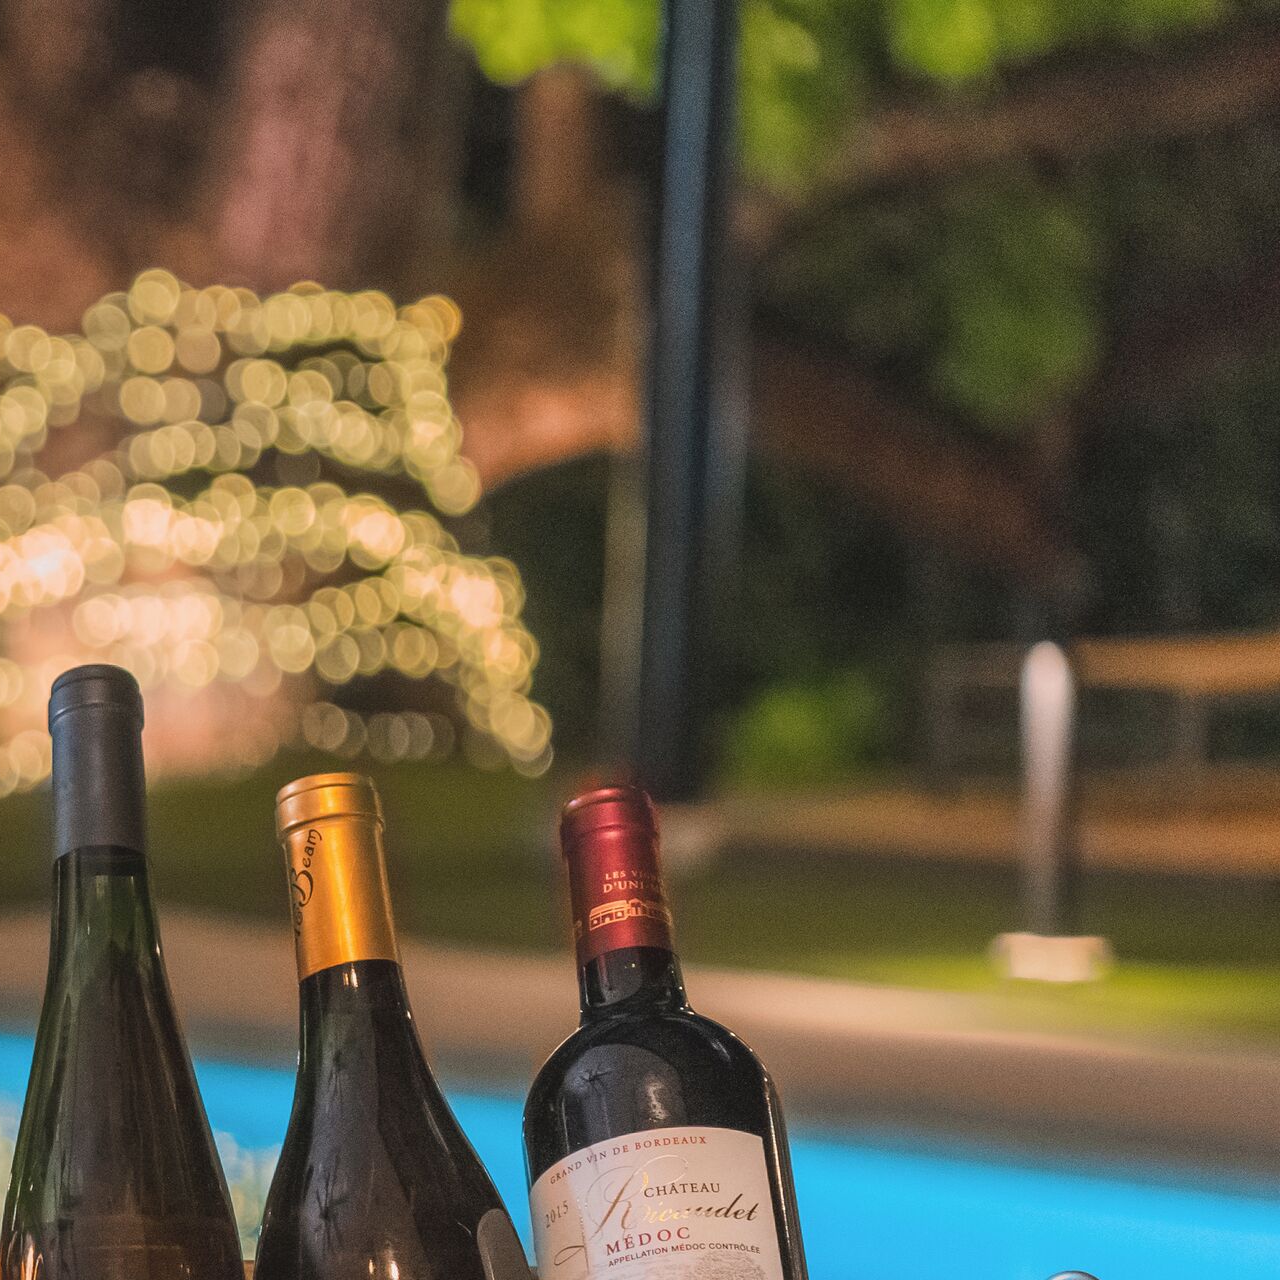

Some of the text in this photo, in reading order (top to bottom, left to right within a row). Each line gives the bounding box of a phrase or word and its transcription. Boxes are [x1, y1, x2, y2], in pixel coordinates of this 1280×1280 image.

[605, 870, 627, 881] LES
[549, 1135, 707, 1185] GRAND VIN DE BORDEAUX
[643, 1181, 721, 1198] CHÂTEAU
[544, 1200, 570, 1230] 2015
[605, 1226, 691, 1257] MÉDOC
[607, 1241, 761, 1268] APPELLATION MÉDOC CONTRÔLÉE
